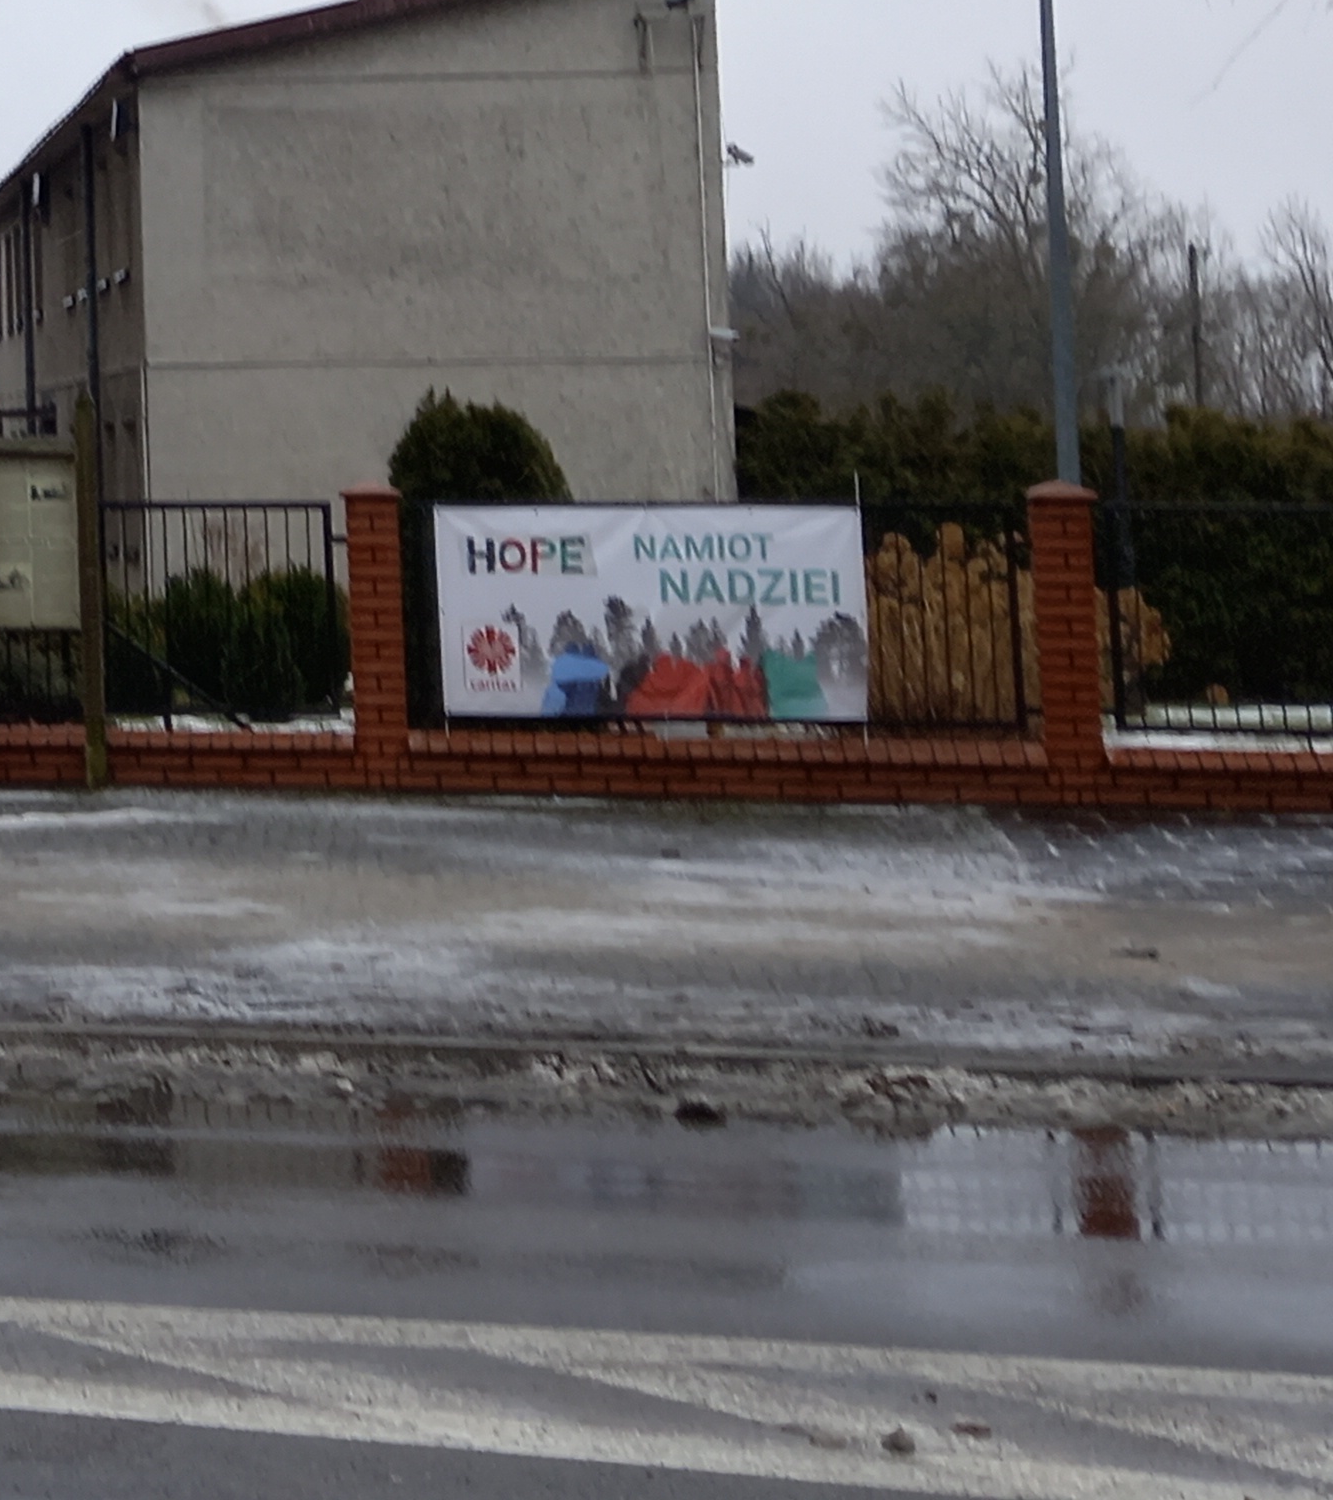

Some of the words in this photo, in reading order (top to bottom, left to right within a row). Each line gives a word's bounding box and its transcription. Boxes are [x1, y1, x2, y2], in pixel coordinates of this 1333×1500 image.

[466, 534, 586, 576] HOPE
[633, 531, 774, 563] NAMIOT
[658, 566, 841, 607] NADZIEI
